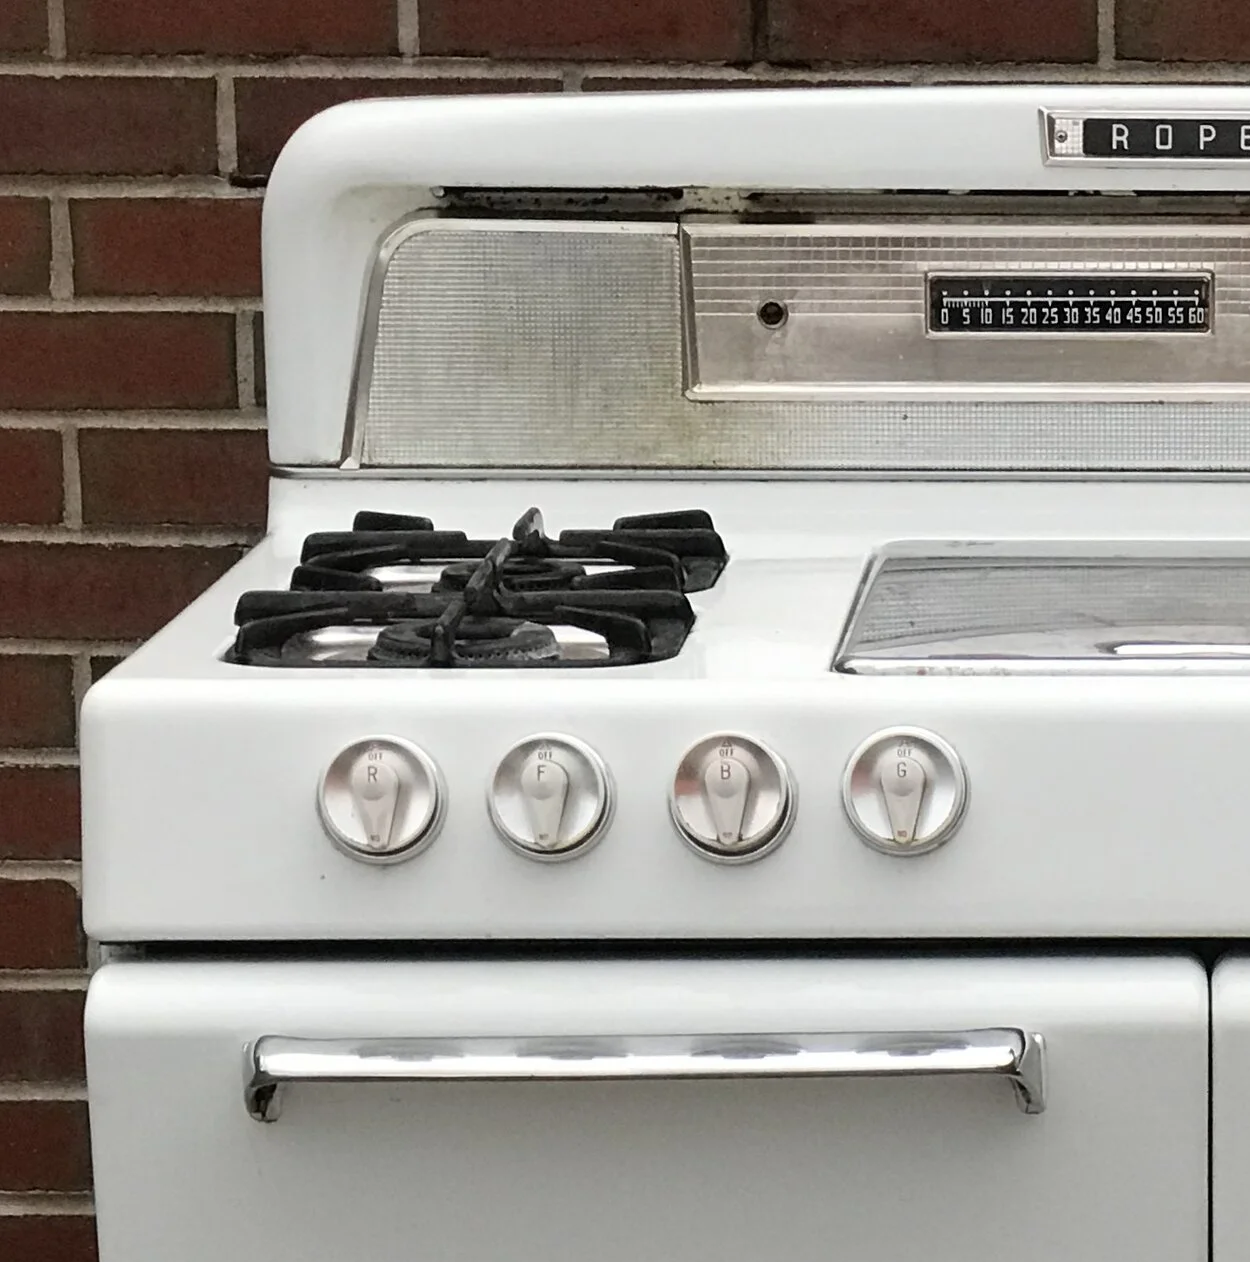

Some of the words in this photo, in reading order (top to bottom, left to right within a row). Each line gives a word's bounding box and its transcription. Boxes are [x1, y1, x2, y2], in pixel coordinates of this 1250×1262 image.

[941, 308, 949, 325] 0
[963, 308, 970, 325] 5
[981, 308, 993, 325] 10
[1002, 308, 1014, 325] 15
[1021, 308, 1037, 325] 20
[1042, 308, 1058, 325] 25
[1063, 308, 1079, 325] 30
[1084, 308, 1100, 325] 35
[1105, 308, 1121, 325] 40
[1126, 308, 1142, 325] 45
[1146, 308, 1162, 325] 50
[1168, 308, 1184, 325] 55
[1188, 308, 1205, 325] 60
[367, 765, 378, 783] R
[537, 764, 547, 781] F
[720, 763, 731, 780] B
[897, 761, 907, 778] G
